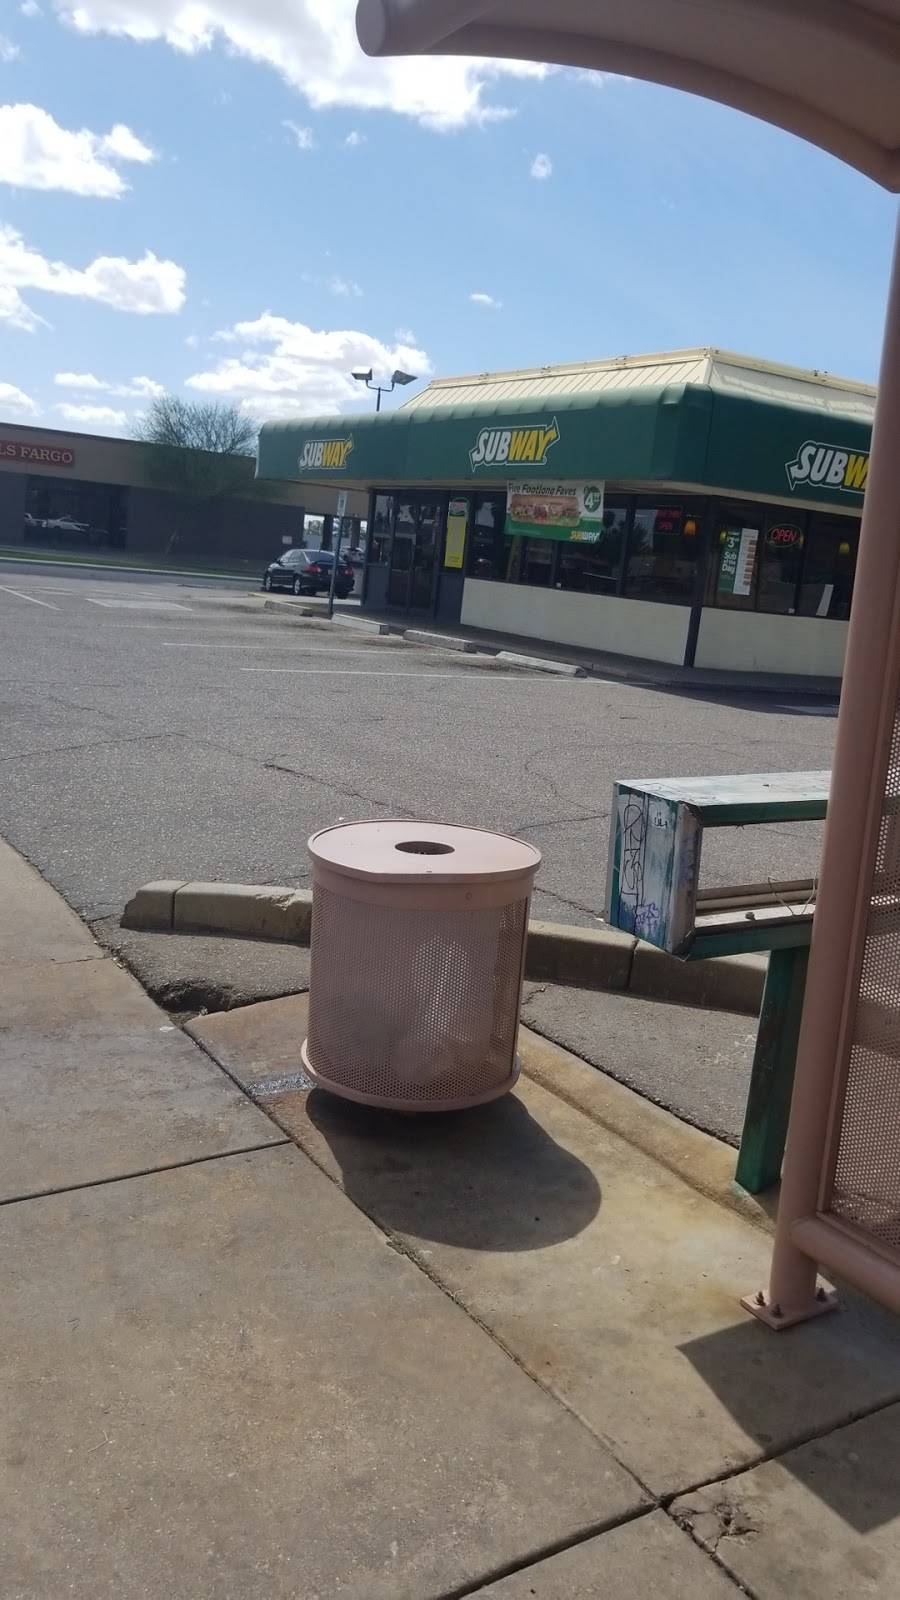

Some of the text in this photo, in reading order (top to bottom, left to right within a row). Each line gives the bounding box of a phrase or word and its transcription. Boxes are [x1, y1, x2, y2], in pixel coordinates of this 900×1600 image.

[298, 439, 353, 467] SUBWAY
[470, 427, 557, 463] SUBWAY
[20, 446, 73, 464] FARGO
[790, 445, 869, 489] SUBW
[522, 484, 554, 496] Footlong
[555, 486, 577, 497] Faves
[570, 531, 600, 543] SUBWAY
[771, 528, 798, 544] OPEN
[724, 551, 737, 561] Sub
[721, 563, 735, 575] Day
